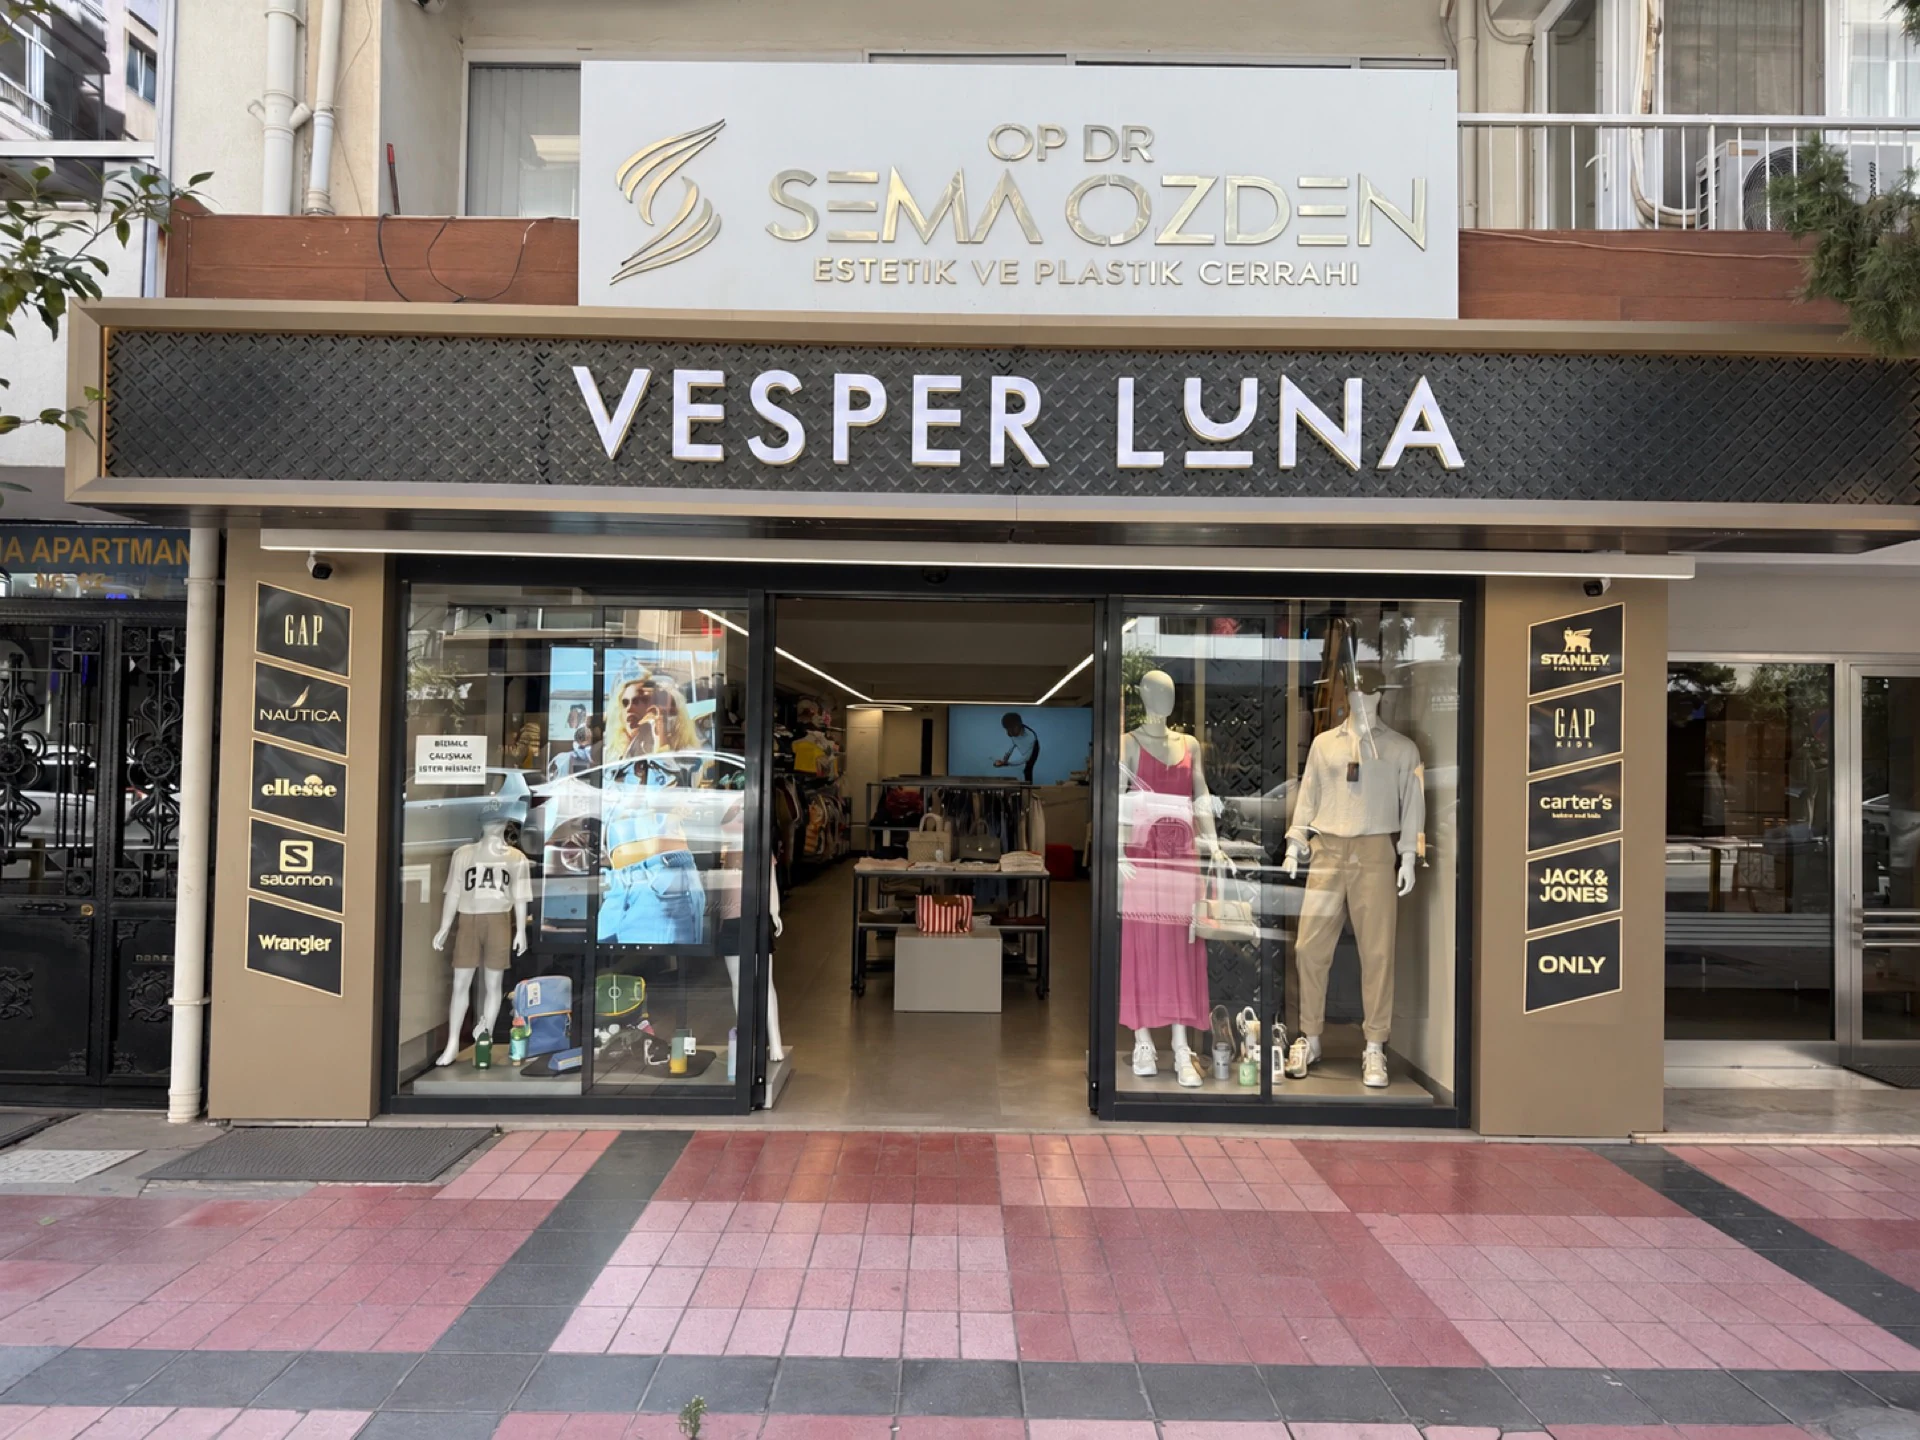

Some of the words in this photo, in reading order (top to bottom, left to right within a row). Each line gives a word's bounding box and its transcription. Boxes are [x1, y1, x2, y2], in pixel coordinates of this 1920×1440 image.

[987, 123, 1068, 162] OP
[1083, 124, 1155, 162] DR
[765, 166, 1043, 245] SEMA
[813, 257, 957, 285] ESTETIK
[971, 259, 1019, 286] VE
[1035, 259, 1183, 287] PLASTIK
[1199, 260, 1359, 286] CERRAHI
[572, 365, 1050, 469] VESPER
[1116, 374, 1466, 472] LUNA
[284, 614, 323, 646] GAP
[1540, 653, 1610, 667] STANLEY
[260, 708, 341, 722] NAUTICA
[1554, 707, 1595, 739] GAP
[261, 778, 338, 797] ellesse
[1540, 794, 1613, 810] carter's
[260, 874, 334, 887] salomon
[465, 866, 510, 892] GAP
[1540, 868, 1609, 886] JACK&
[1540, 886, 1609, 903] JONES
[258, 934, 332, 956] Wrangler
[1538, 955, 1607, 974] ONLY
